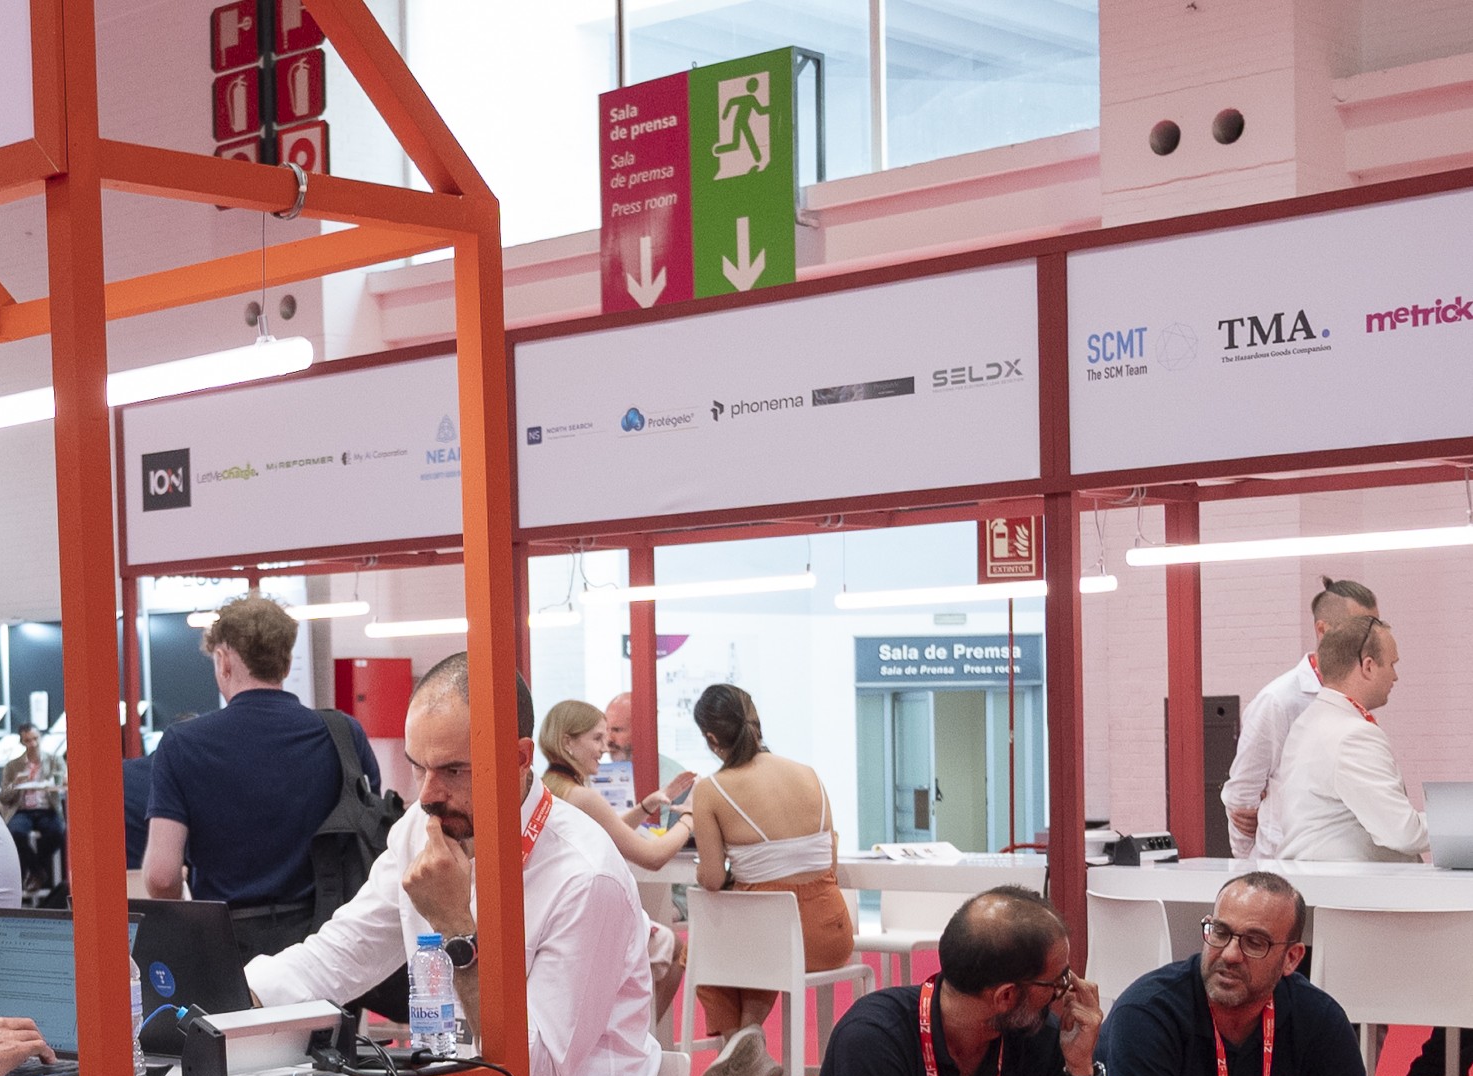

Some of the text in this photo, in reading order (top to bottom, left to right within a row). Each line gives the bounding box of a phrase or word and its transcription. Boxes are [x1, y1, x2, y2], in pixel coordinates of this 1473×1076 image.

[610, 104, 638, 122] Sala
[610, 115, 677, 141] de prensa
[610, 151, 635, 169] Sala
[610, 166, 674, 189] de premsa
[611, 193, 678, 217] Press room
[1087, 327, 1147, 364] SCMT
[1235, 352, 1269, 361] Hazardous
[1271, 347, 1291, 357] Goods
[1293, 344, 1332, 354] Companion
[933, 358, 1023, 388] SELDX
[1087, 364, 1147, 381] The SCM Team
[731, 396, 803, 418] phonema
[528, 430, 541, 441] NS
[426, 447, 460, 464] NEA
[992, 565, 1030, 573] EXTINTOR
[879, 643, 1022, 661] Sala de Premsa
[880, 665, 903, 676] Sala
[905, 665, 918, 675] de
[920, 664, 955, 675] Prensa
[963, 664, 992, 674] Press
[524, 821, 539, 842] ZF
[411, 1006, 439, 1019] Ribes
[920, 1018, 931, 1033] ZF
[1217, 1058, 1226, 1073] ZF
